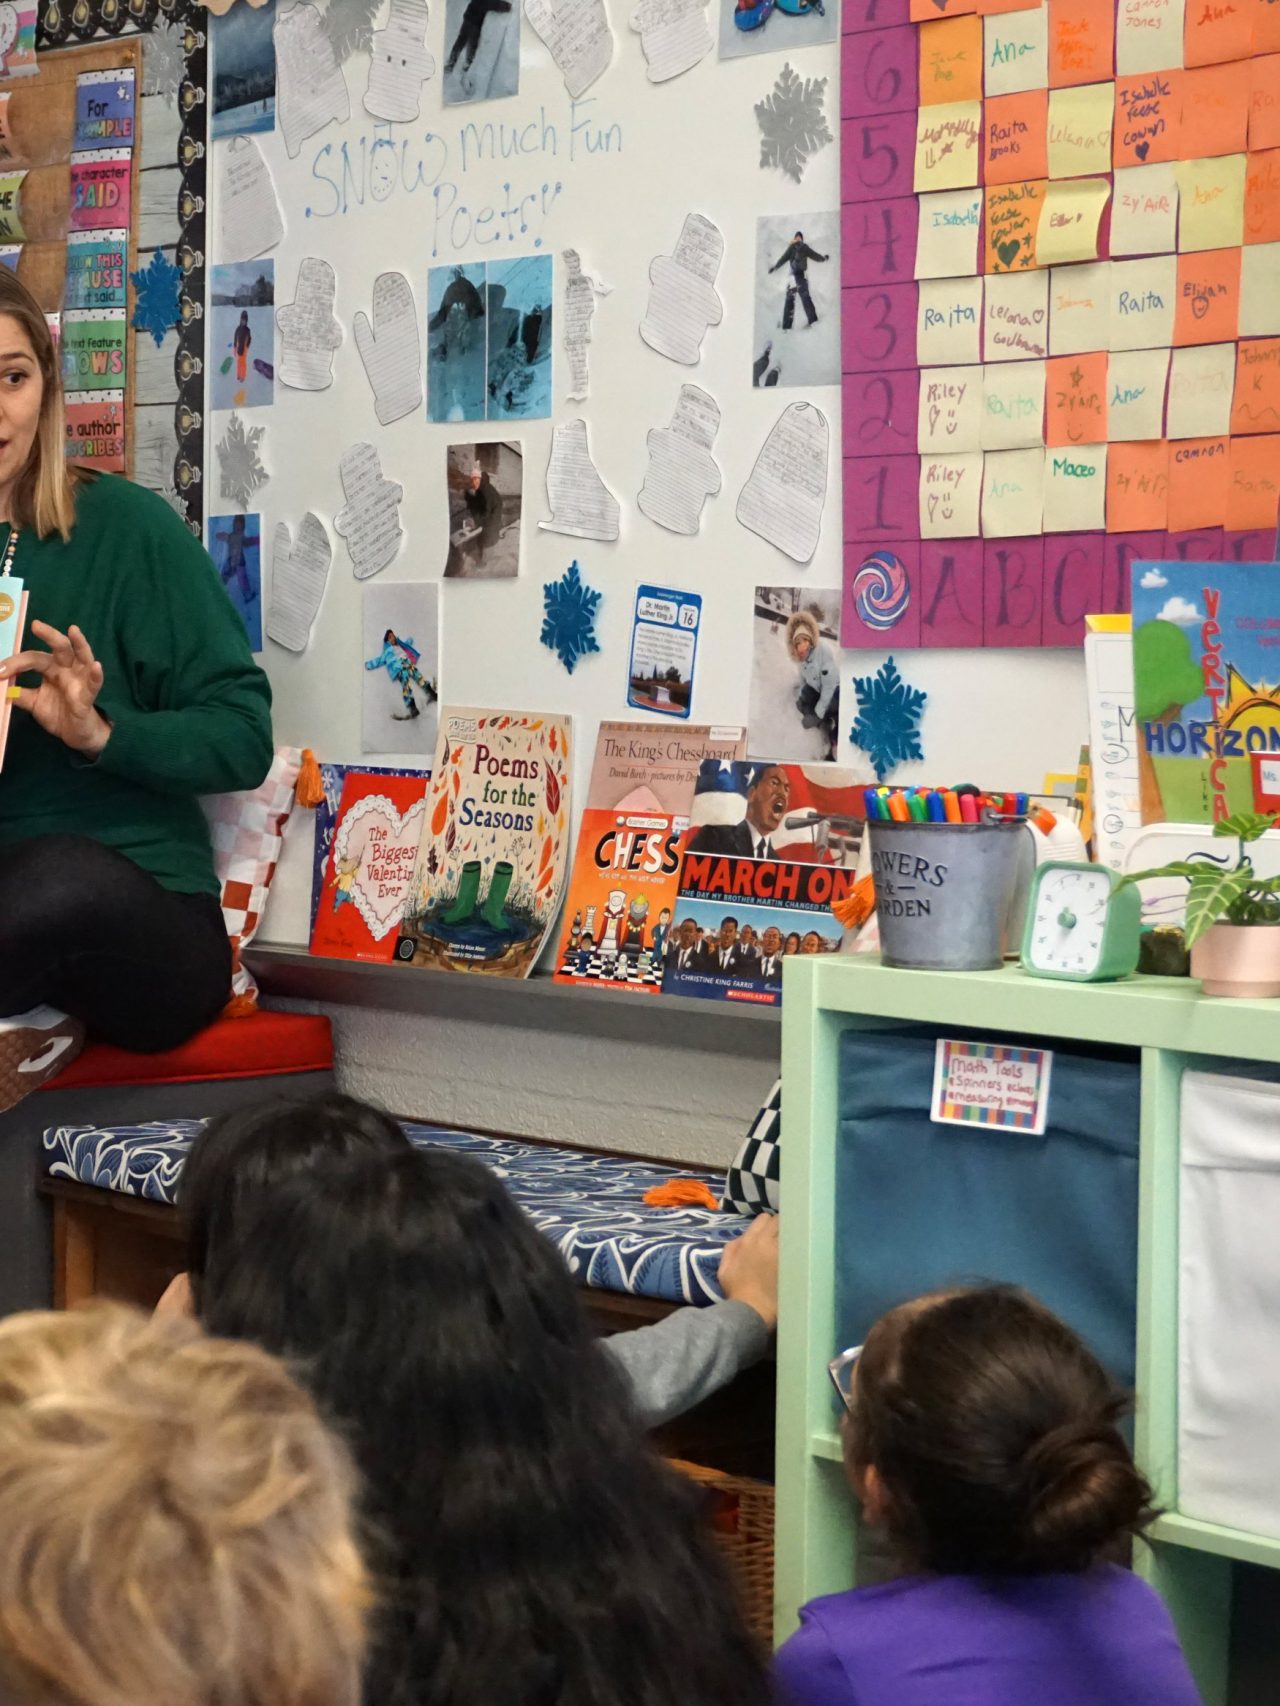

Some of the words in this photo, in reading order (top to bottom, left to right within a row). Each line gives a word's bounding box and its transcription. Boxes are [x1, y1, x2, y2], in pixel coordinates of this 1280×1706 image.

[991, 39, 1036, 67] Ana
[864, 40, 901, 106] 6
[87, 99, 109, 117] For
[857, 125, 899, 189] 5
[74, 182, 119, 209] SAID
[859, 208, 904, 274] 4
[856, 293, 897, 361] 3
[927, 383, 967, 405] Riley
[858, 377, 909, 443] 2
[77, 421, 120, 436] author
[926, 464, 965, 489] Riley
[1053, 458, 1096, 477] Maceo
[857, 465, 902, 531] 1
[924, 553, 975, 628] A
[995, 550, 1036, 626] B
[1053, 550, 1088, 623] C
[683, 612, 693, 626] 16
[473, 744, 538, 779] Poems
[604, 738, 626, 758] The
[628, 740, 663, 765] King's
[482, 780, 507, 803] for
[512, 783, 536, 807] the
[459, 797, 534, 832] Seasons
[369, 827, 388, 842] The
[595, 831, 681, 876] CHESS
[378, 884, 402, 898] Ever
[682, 854, 800, 901] MARCH
[807, 868, 856, 904] ON
[885, 883, 895, 895] &
[681, 889, 694, 897] THE
[696, 891, 710, 899] DAY
[712, 892, 722, 900] MY
[723, 893, 755, 904] BROTHER
[756, 898, 783, 907] MARTIN
[785, 901, 819, 911] CHANGED
[680, 974, 715, 985] CHRISTINE
[715, 978, 731, 987] KING
[732, 979, 754, 989] FARRIS
[952, 1058, 988, 1074] Math
[992, 1060, 1023, 1078] Tools
